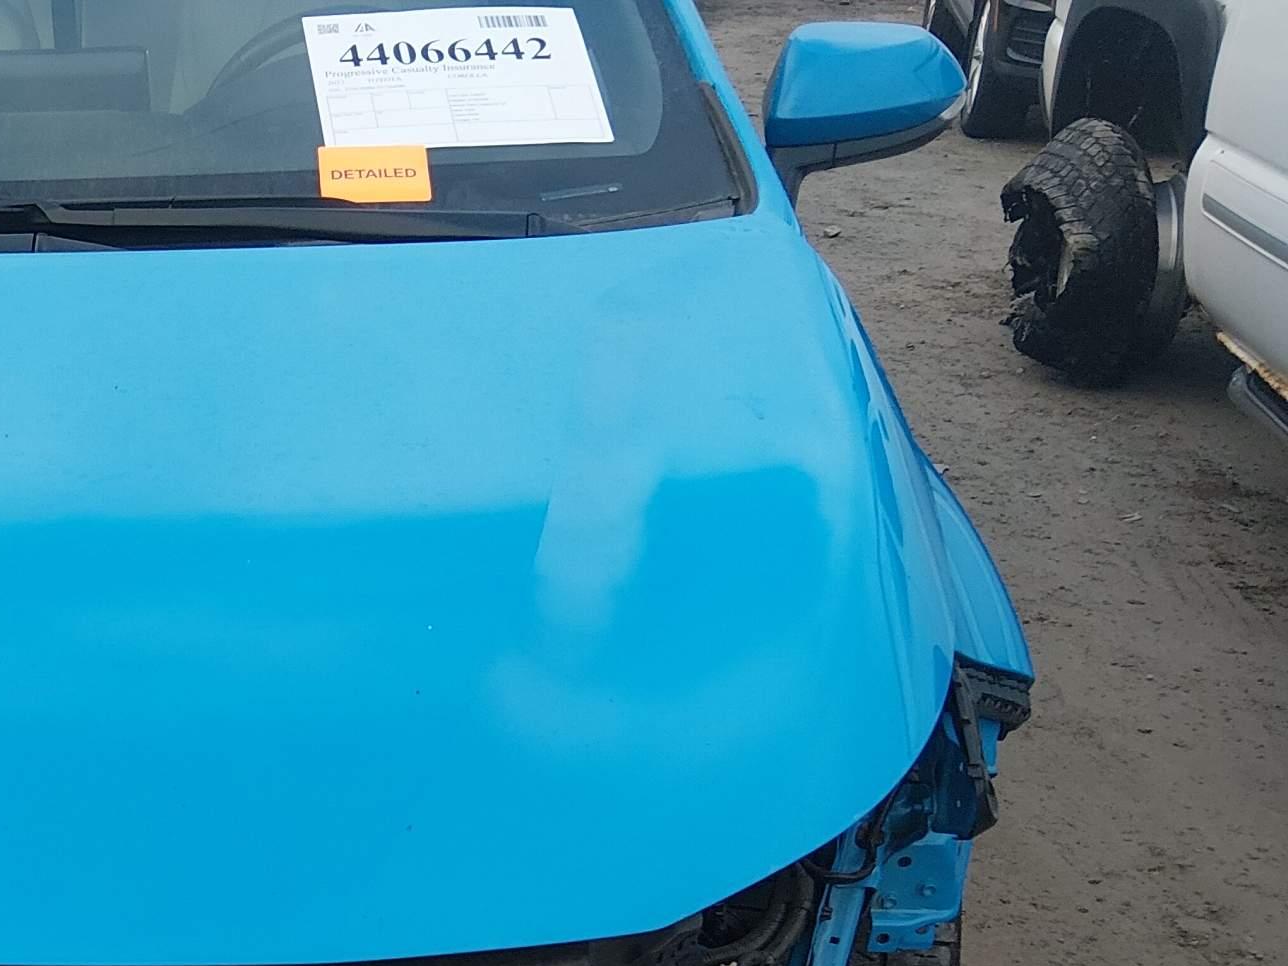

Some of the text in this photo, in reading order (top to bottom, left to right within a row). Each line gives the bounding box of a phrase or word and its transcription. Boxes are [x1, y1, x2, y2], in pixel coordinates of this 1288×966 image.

[339, 37, 552, 67] 44066442
[325, 63, 495, 79] Progressive Casualty Insurance
[330, 168, 417, 180] DETAILED
